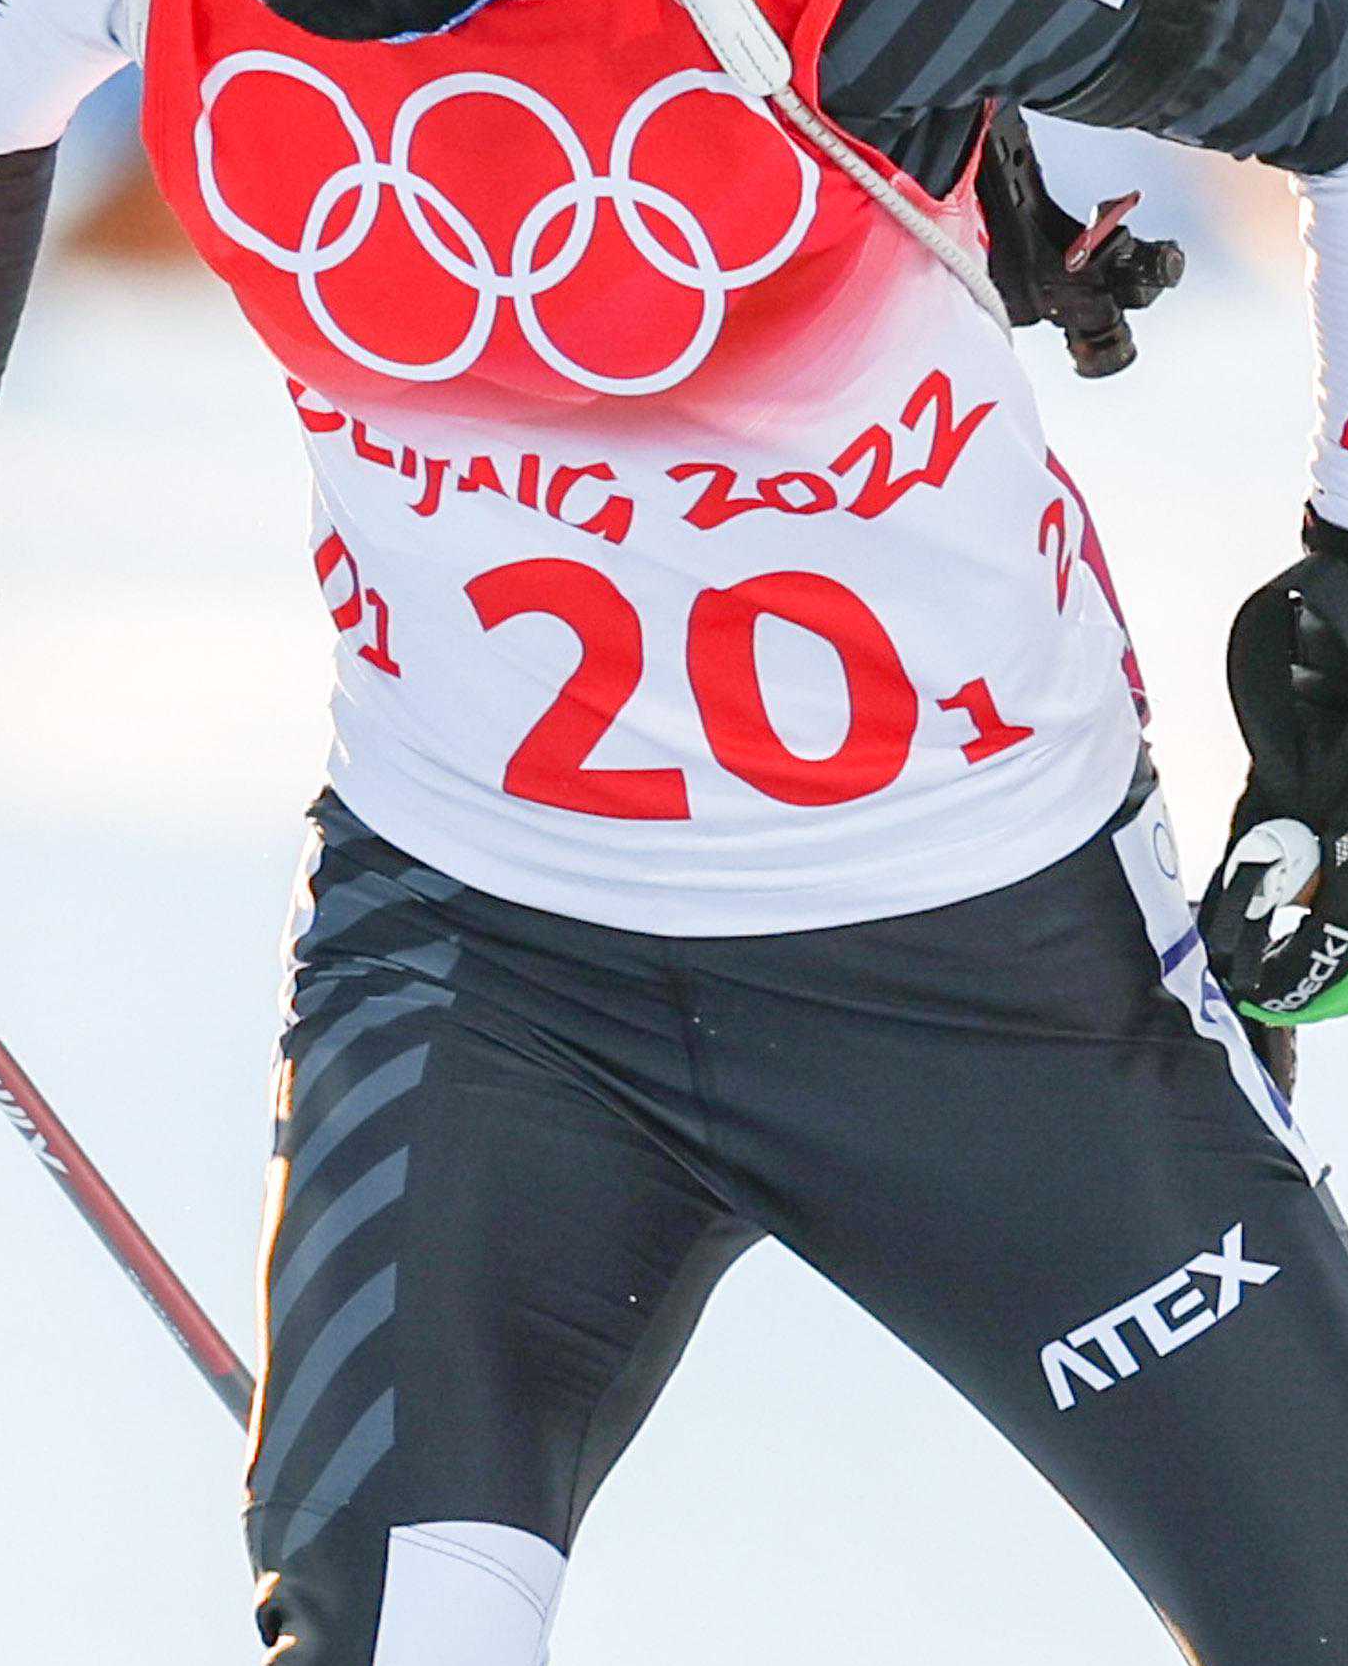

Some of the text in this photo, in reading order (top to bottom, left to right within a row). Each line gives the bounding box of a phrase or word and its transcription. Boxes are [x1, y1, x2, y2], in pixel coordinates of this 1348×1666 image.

[665, 369, 998, 531] 2022
[462, 556, 919, 821] 20
[1039, 1222, 1282, 1411] ATEX
